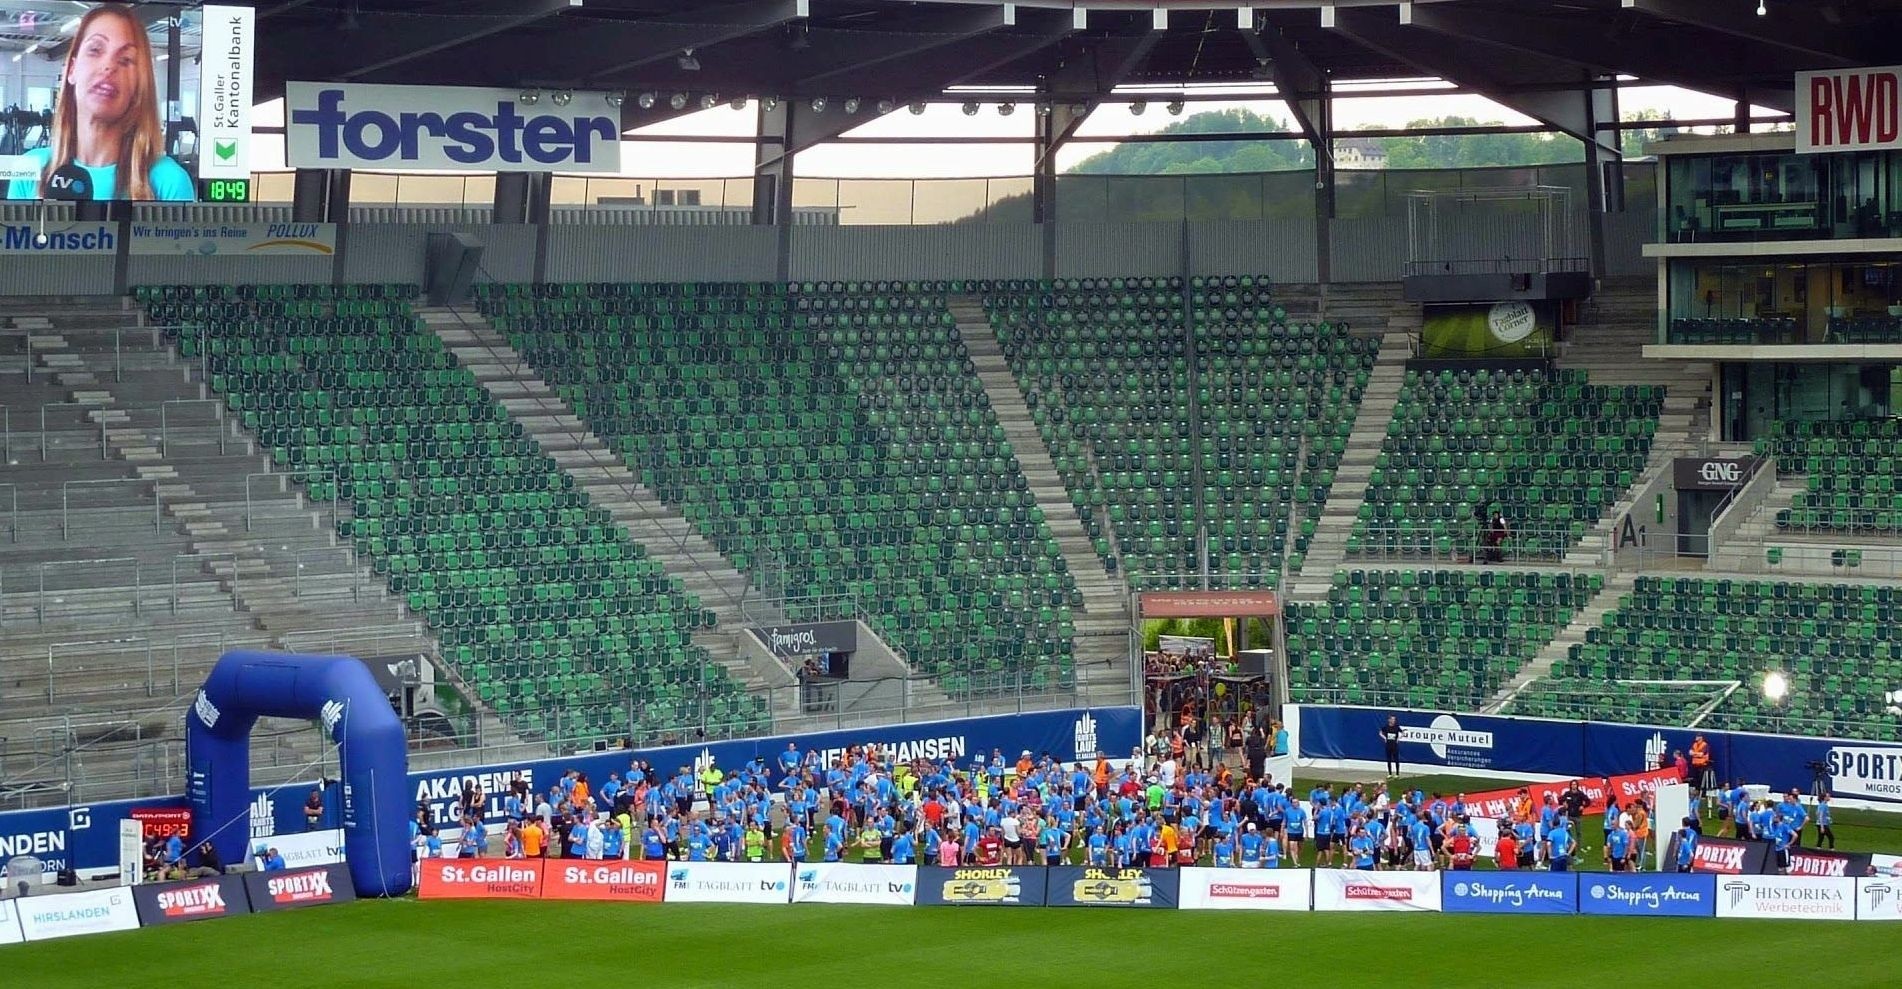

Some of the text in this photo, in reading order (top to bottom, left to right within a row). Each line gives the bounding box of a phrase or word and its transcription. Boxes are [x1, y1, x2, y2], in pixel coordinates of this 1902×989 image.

[227, 16, 242, 128] Kantonalbank
[1811, 73, 1899, 147] RWD
[292, 90, 617, 164] forster
[133, 226, 247, 240] Wir bringen's ins Reine
[267, 224, 318, 238] POLLUX
[1697, 462, 1743, 481] GNG
[1402, 728, 1489, 744] Groupe Mutuel
[883, 736, 965, 764] HANSEN
[1076, 741, 1097, 752] LAUF
[1866, 783, 1900, 794] MIGROS
[441, 866, 535, 883] St.Gallen
[564, 867, 657, 884] St.Gallen
[955, 869, 1011, 879] SHORLEY
[487, 883, 534, 894] HostCity
[609, 885, 656, 896] HostCity
[697, 880, 753, 891] TAGBLATT
[826, 881, 880, 893] TAGBLATT
[1756, 886, 1842, 900] HISTORIKA
[1470, 883, 1562, 906] Shopping Arena
[1607, 885, 1700, 908] Shopping Arena
[34, 907, 110, 923] HIRSLANDEN
[1756, 902, 1843, 914] Werbetechnik
